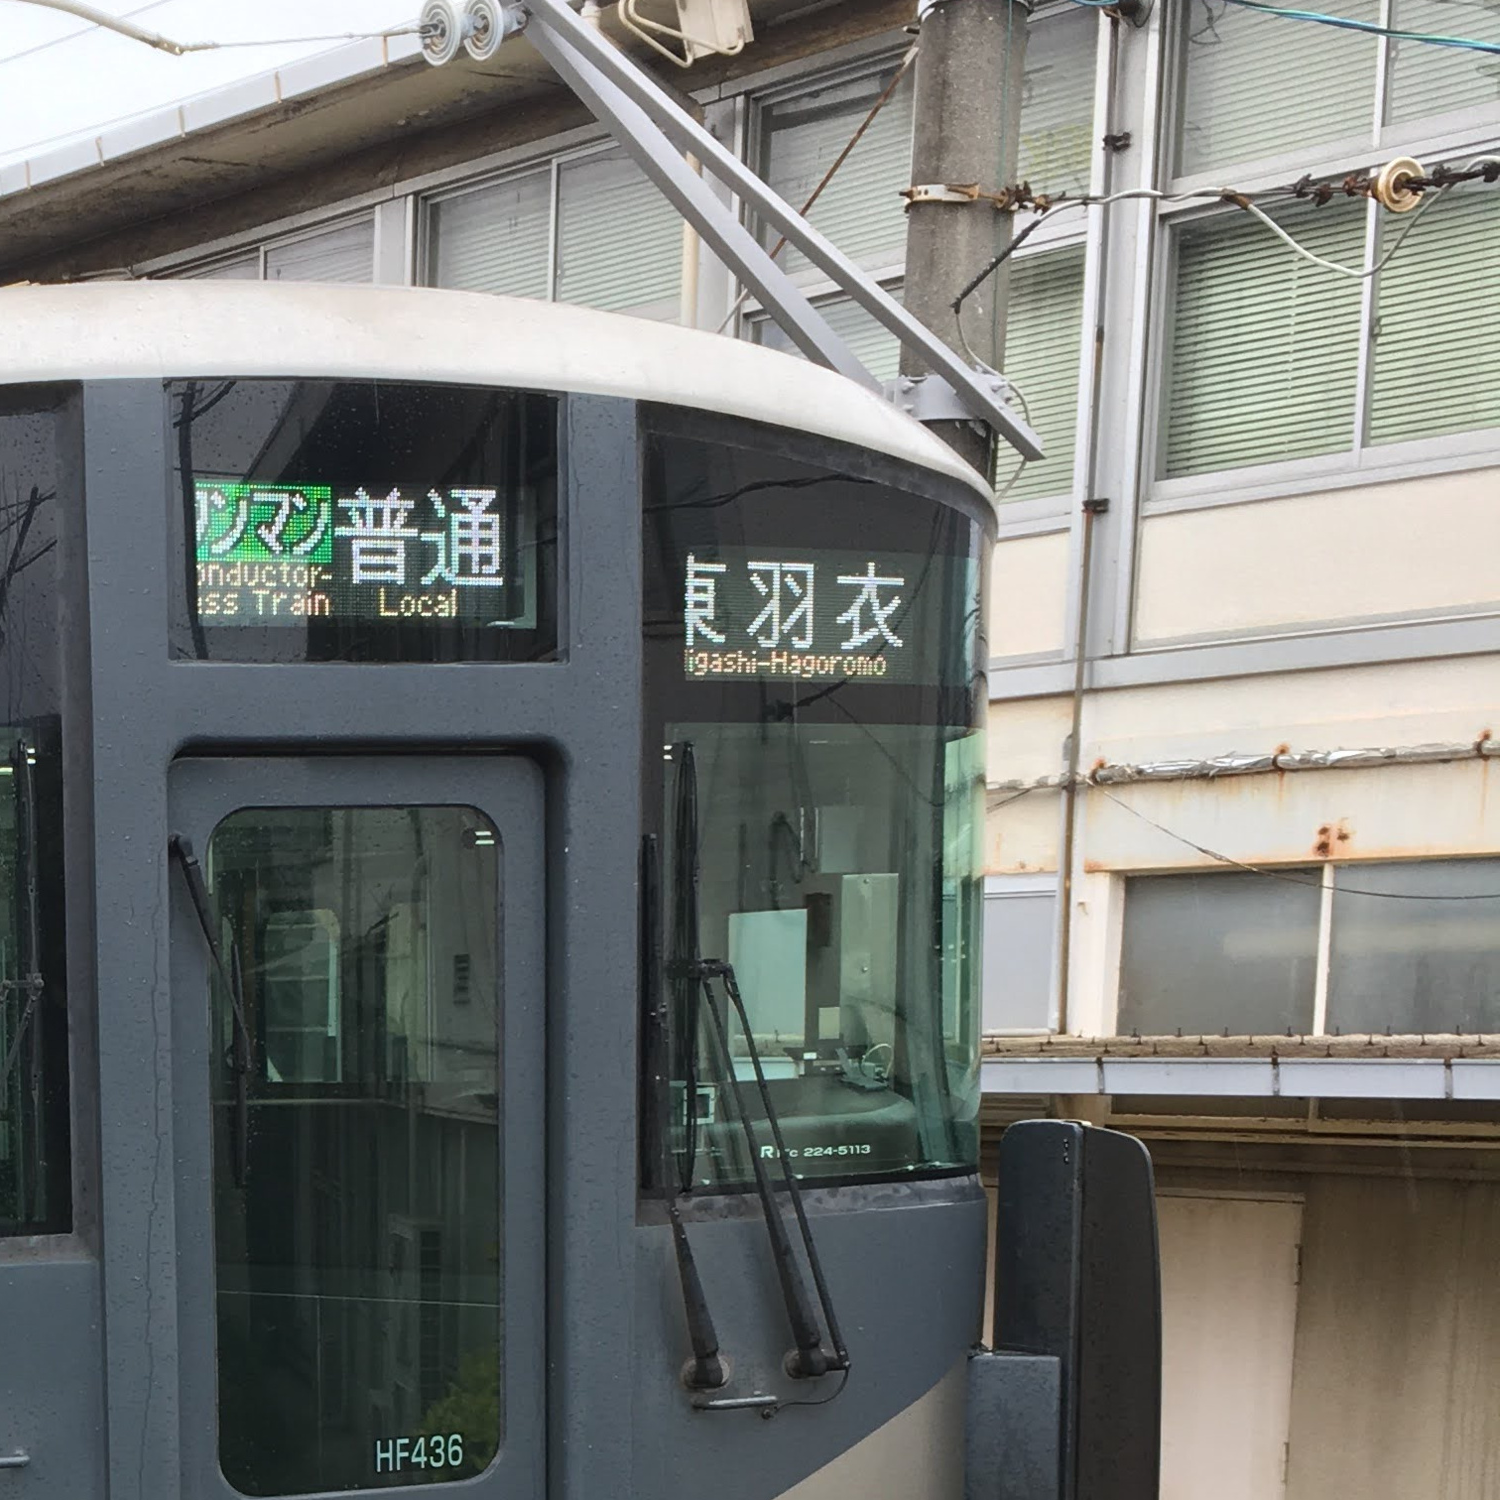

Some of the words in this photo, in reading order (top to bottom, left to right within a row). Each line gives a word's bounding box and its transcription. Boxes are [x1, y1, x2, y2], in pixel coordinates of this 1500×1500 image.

[335, 486, 503, 586] 普通
[197, 561, 333, 586] onductor-
[252, 589, 330, 616] Train
[379, 587, 459, 617] Local
[685, 649, 888, 678] igashi-Hagoromo
[803, 1144, 871, 1157] 224-5113
[376, 1433, 463, 1473] HF436
